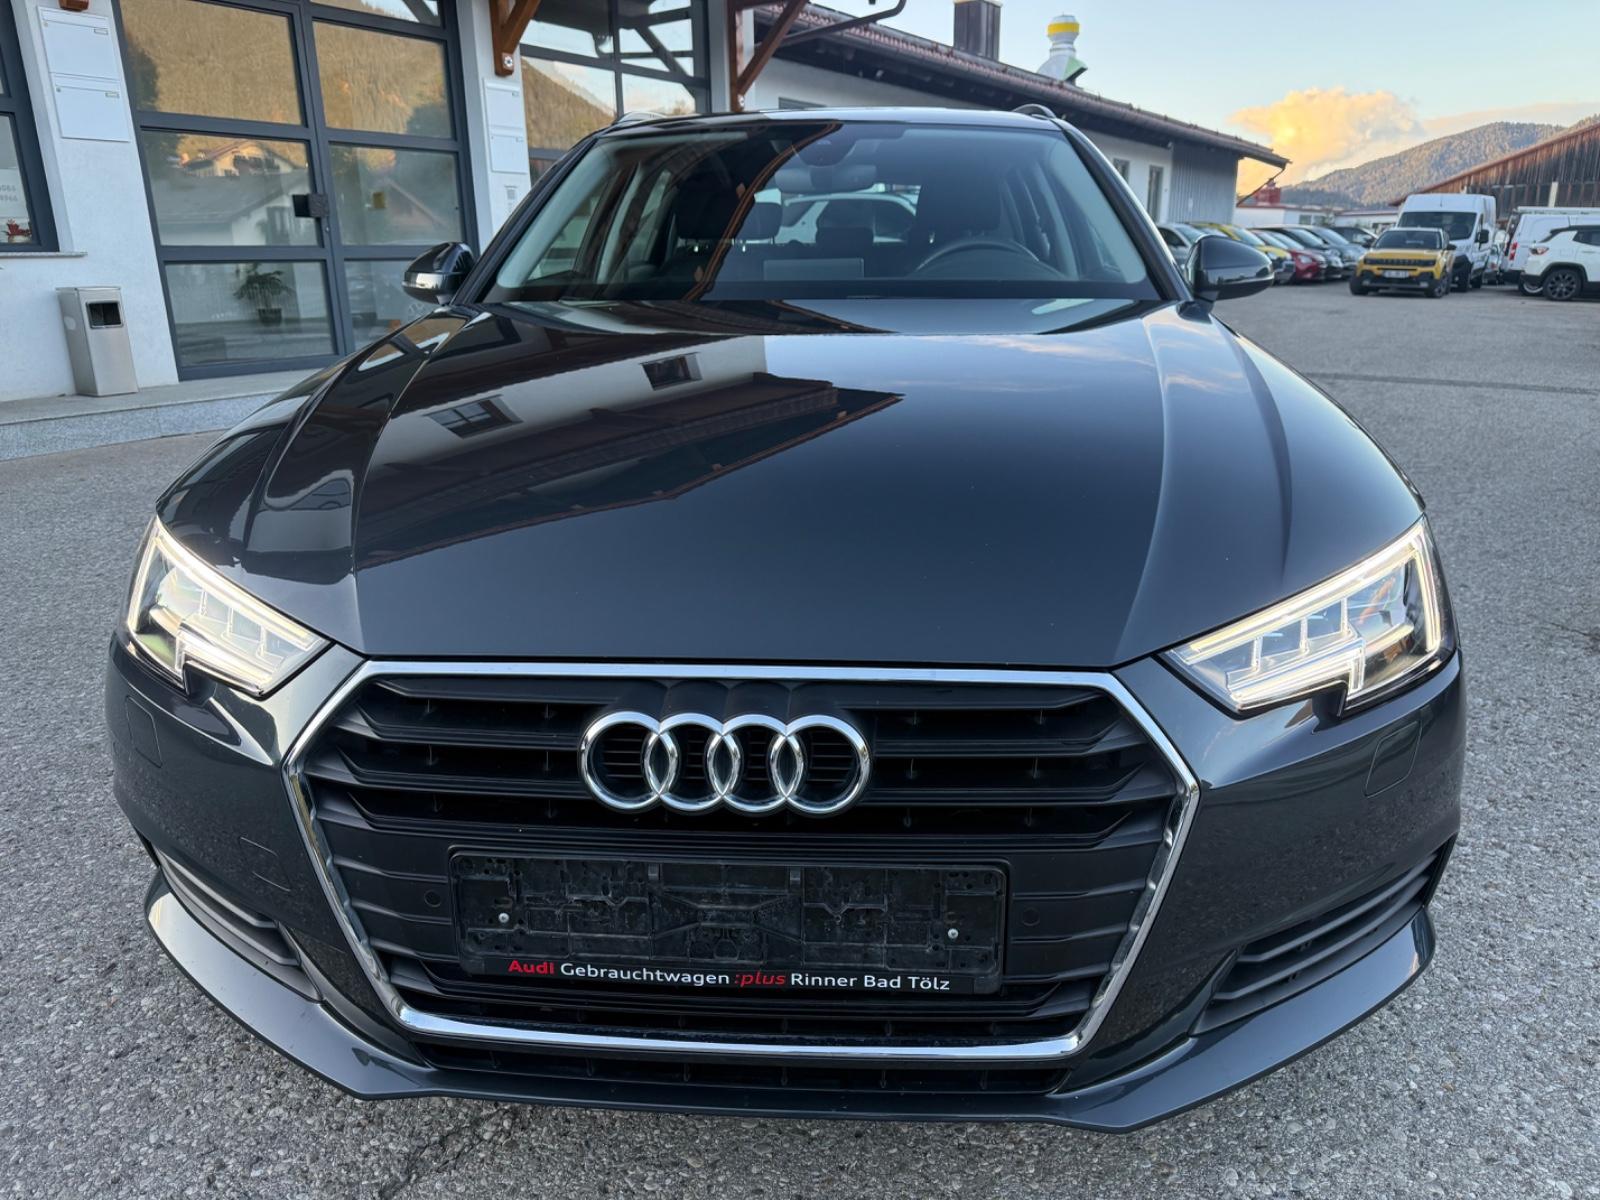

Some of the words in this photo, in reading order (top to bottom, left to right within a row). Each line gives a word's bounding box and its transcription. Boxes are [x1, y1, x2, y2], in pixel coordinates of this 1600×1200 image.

[508, 959, 555, 974] Audi
[560, 962, 730, 987] Gebrauchtwagen
[735, 971, 786, 987] :plus
[791, 972, 858, 987] Rinner
[863, 974, 901, 989] Bad
[907, 976, 951, 991] Tölz
